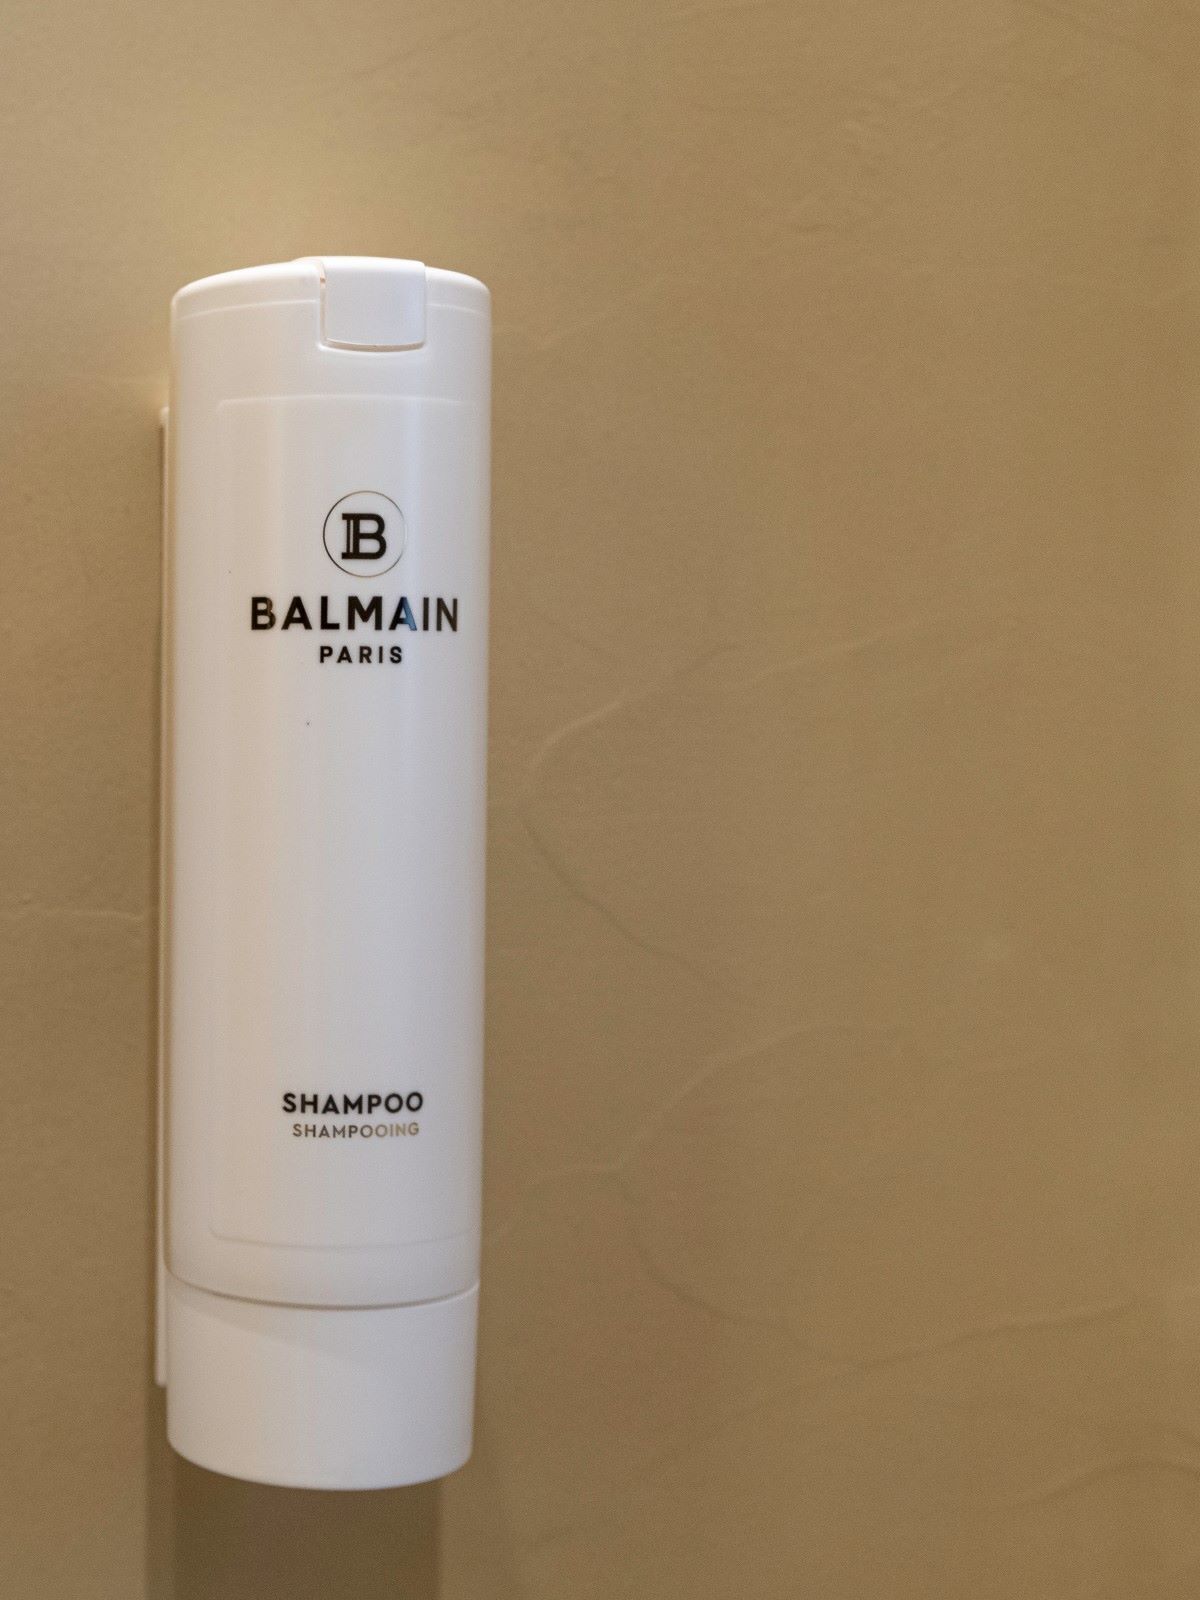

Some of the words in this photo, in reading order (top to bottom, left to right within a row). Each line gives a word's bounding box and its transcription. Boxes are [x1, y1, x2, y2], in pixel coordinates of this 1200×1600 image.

[341, 512, 388, 560] B
[250, 595, 459, 633] BALMAIN
[318, 645, 403, 665] PARIS
[281, 1090, 425, 1116] SHAMPOO
[292, 1121, 420, 1139] SHAMPOOING
